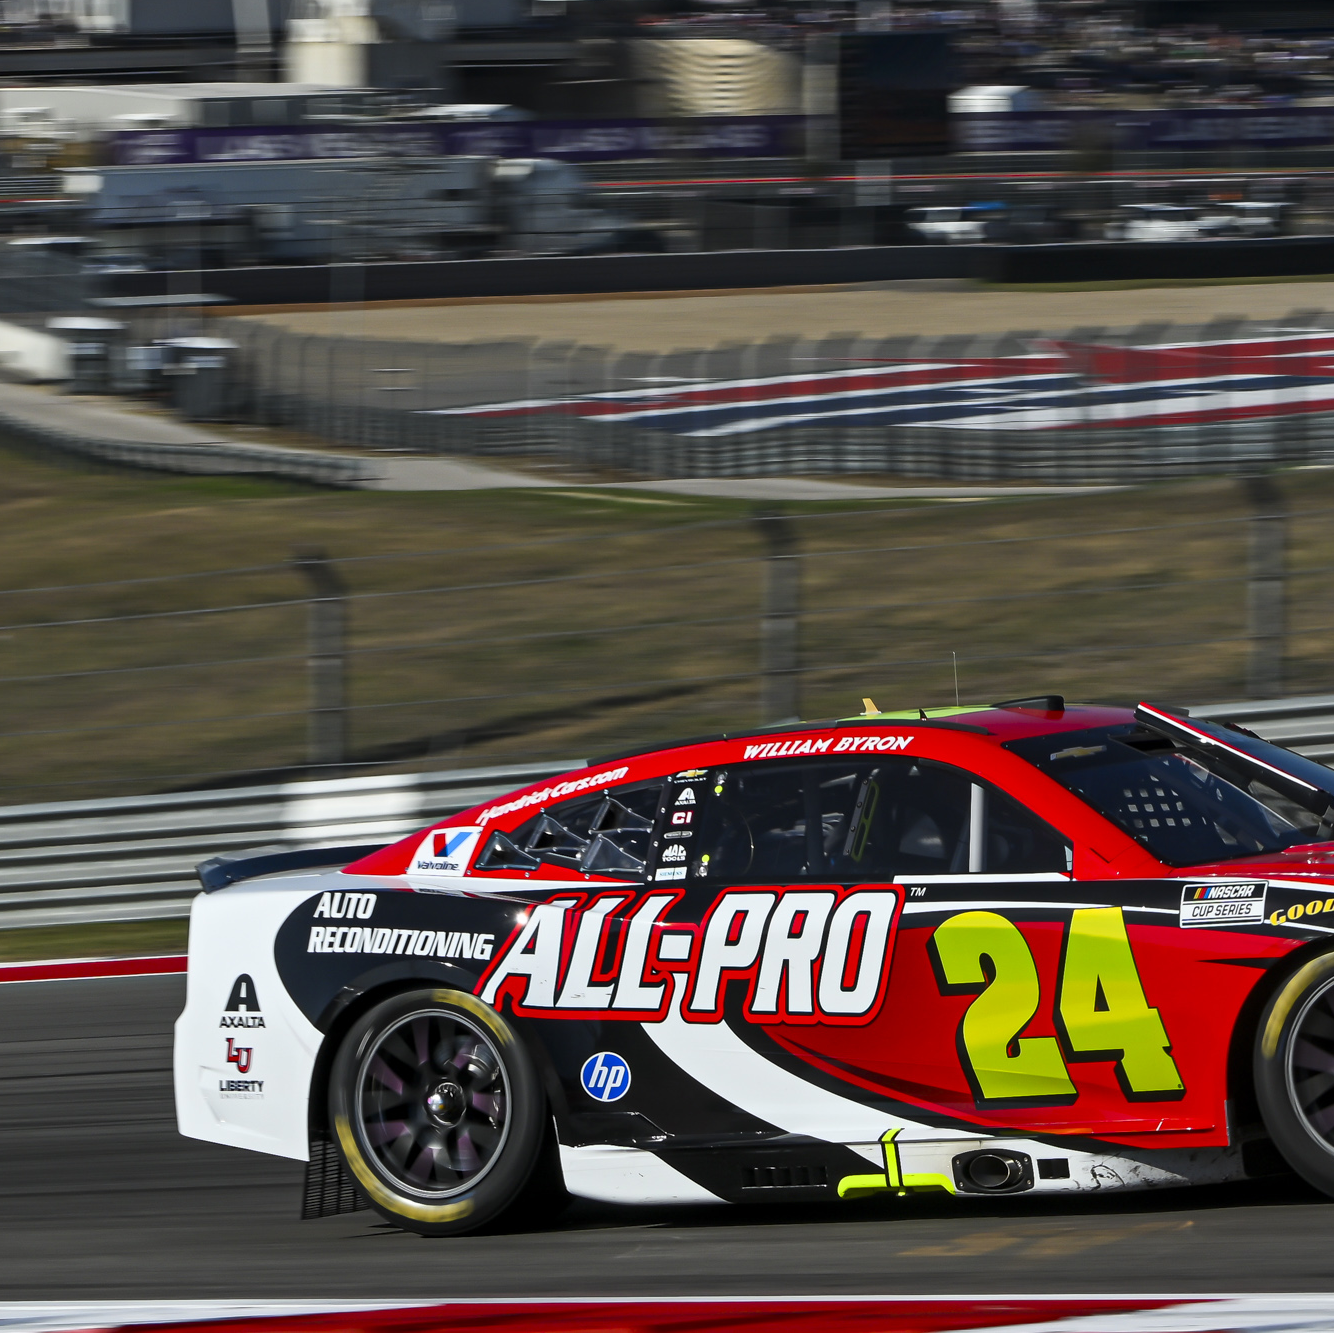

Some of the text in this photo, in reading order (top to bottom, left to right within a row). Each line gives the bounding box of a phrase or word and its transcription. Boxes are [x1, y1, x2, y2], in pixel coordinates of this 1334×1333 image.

[743, 736, 914, 760] WILLIAM BYRON
[663, 844, 687, 857] MAC
[417, 860, 460, 872] Valvoline
[662, 855, 686, 863] TOOLS
[1207, 885, 1255, 900] NASCAR
[313, 892, 377, 919] AUTO
[1192, 903, 1252, 918] CUP SERIES
[307, 926, 495, 961] RECONDITIONING
[477, 888, 902, 1021] ALL-PRO
[930, 906, 1184, 1104] 24
[219, 1016, 266, 1028] AXALTA
[588, 1054, 627, 1101] hp
[219, 1079, 265, 1092] LIBERTY
